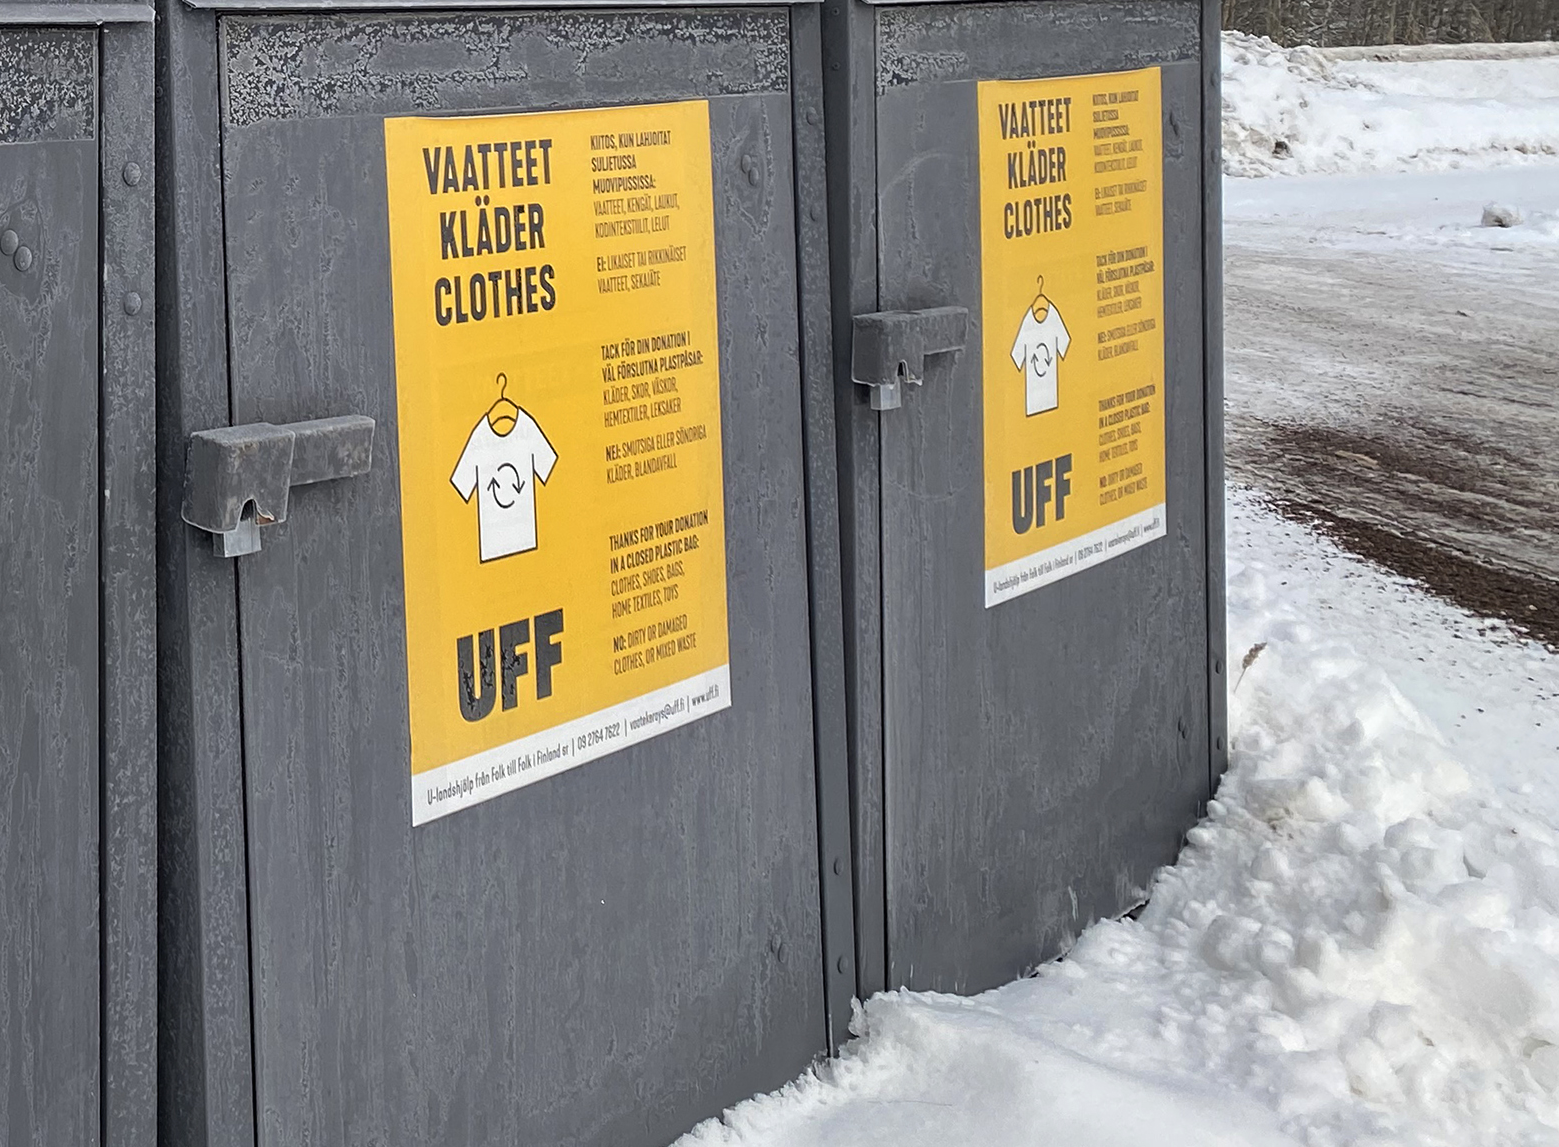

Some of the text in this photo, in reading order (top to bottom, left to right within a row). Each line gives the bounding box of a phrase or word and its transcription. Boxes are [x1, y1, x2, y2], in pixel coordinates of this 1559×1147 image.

[998, 96, 1072, 140] VAATTEET
[423, 139, 551, 194] VAATTEET
[1007, 139, 1067, 190] KLÄDER
[440, 195, 544, 259] KLÄDER
[1003, 192, 1072, 240] CLOTHES
[435, 265, 555, 325] CLOTHES
[1011, 453, 1073, 535] UFF
[457, 609, 563, 721] UFF
